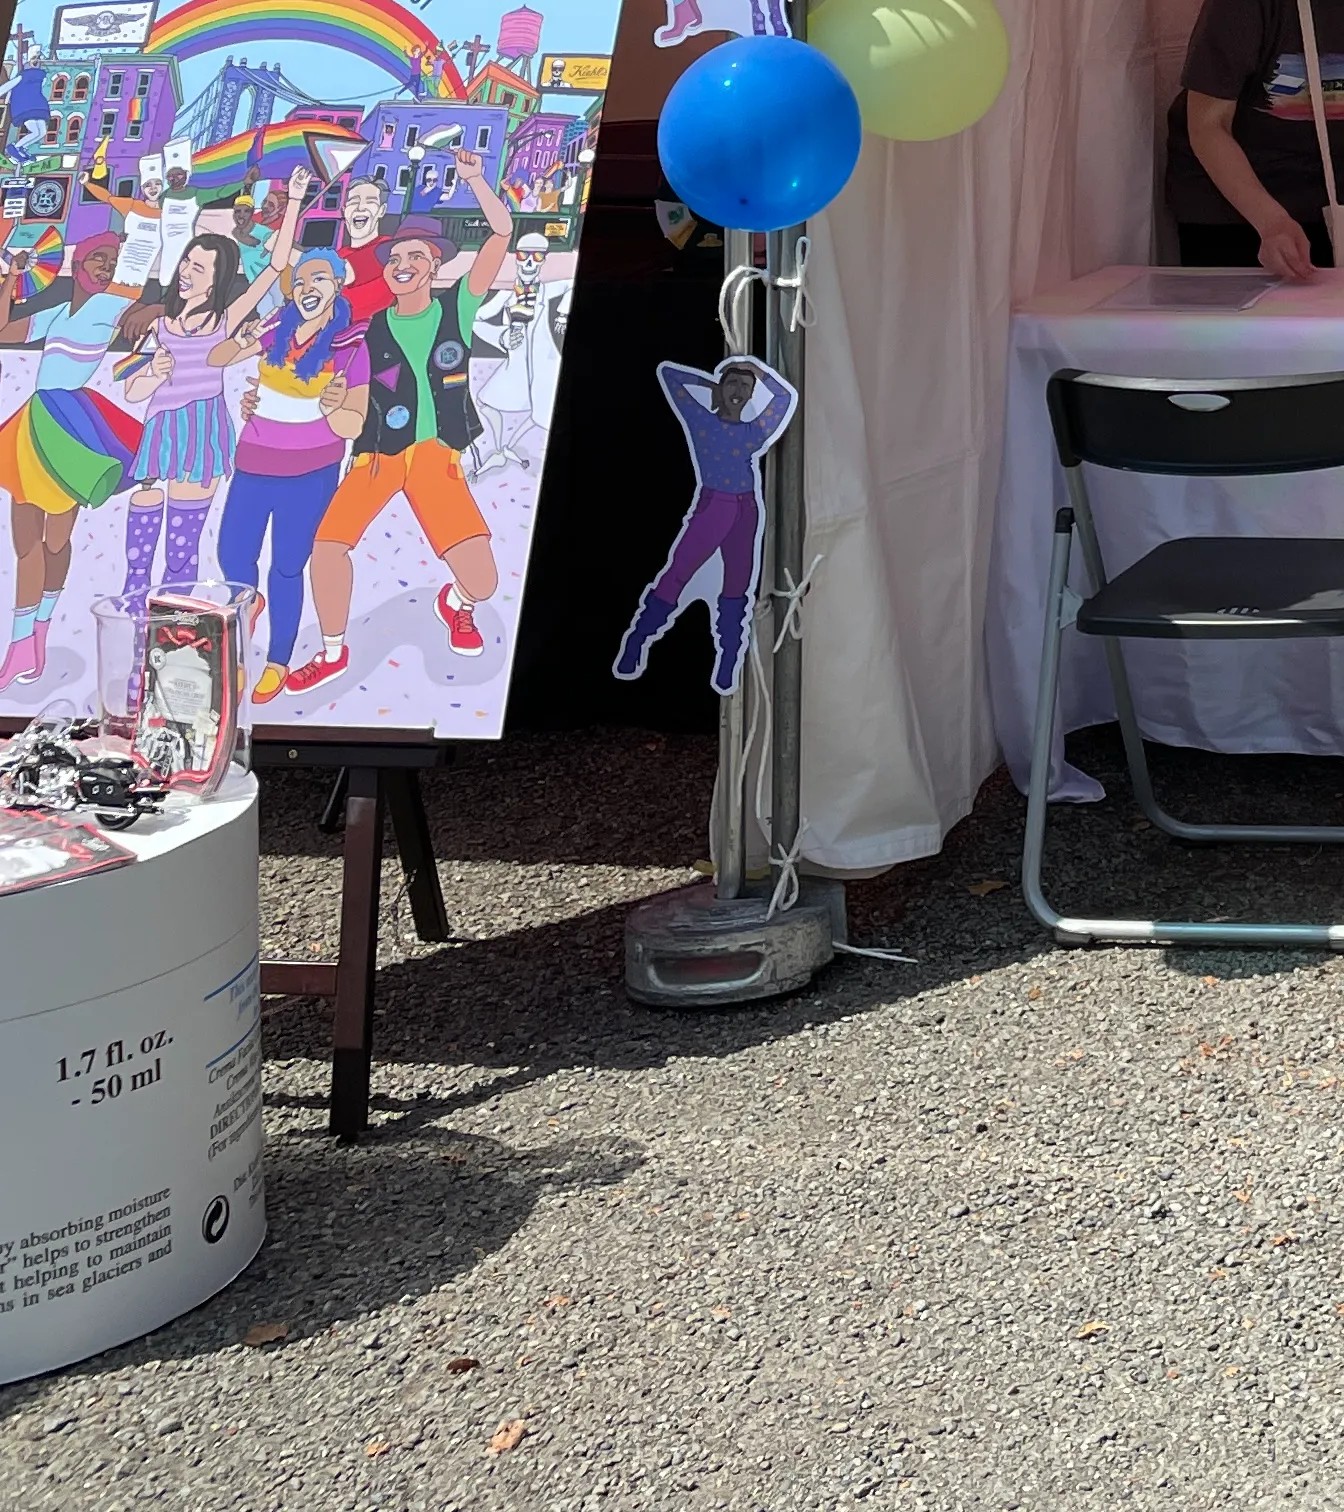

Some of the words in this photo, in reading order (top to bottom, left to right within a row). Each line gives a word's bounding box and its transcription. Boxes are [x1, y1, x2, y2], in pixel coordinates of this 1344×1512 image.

[55, 1048, 97, 1083] 1.7
[106, 1039, 133, 1068] fl.
[140, 1029, 174, 1054] oz.
[91, 1074, 122, 1105] 50
[130, 1057, 161, 1091] ml
[20, 1215, 104, 1250] absorbing
[108, 1187, 171, 1223] moisture
[23, 1245, 69, 1269] helps
[74, 1239, 91, 1253] to
[95, 1205, 171, 1247] strengthen
[13, 1261, 79, 1290] helping
[86, 1254, 103, 1269] to
[109, 1224, 172, 1260] maintain
[23, 1291, 39, 1308] in
[47, 1282, 75, 1301] sea
[82, 1256, 142, 1293] glaciers
[148, 1239, 172, 1263] and
